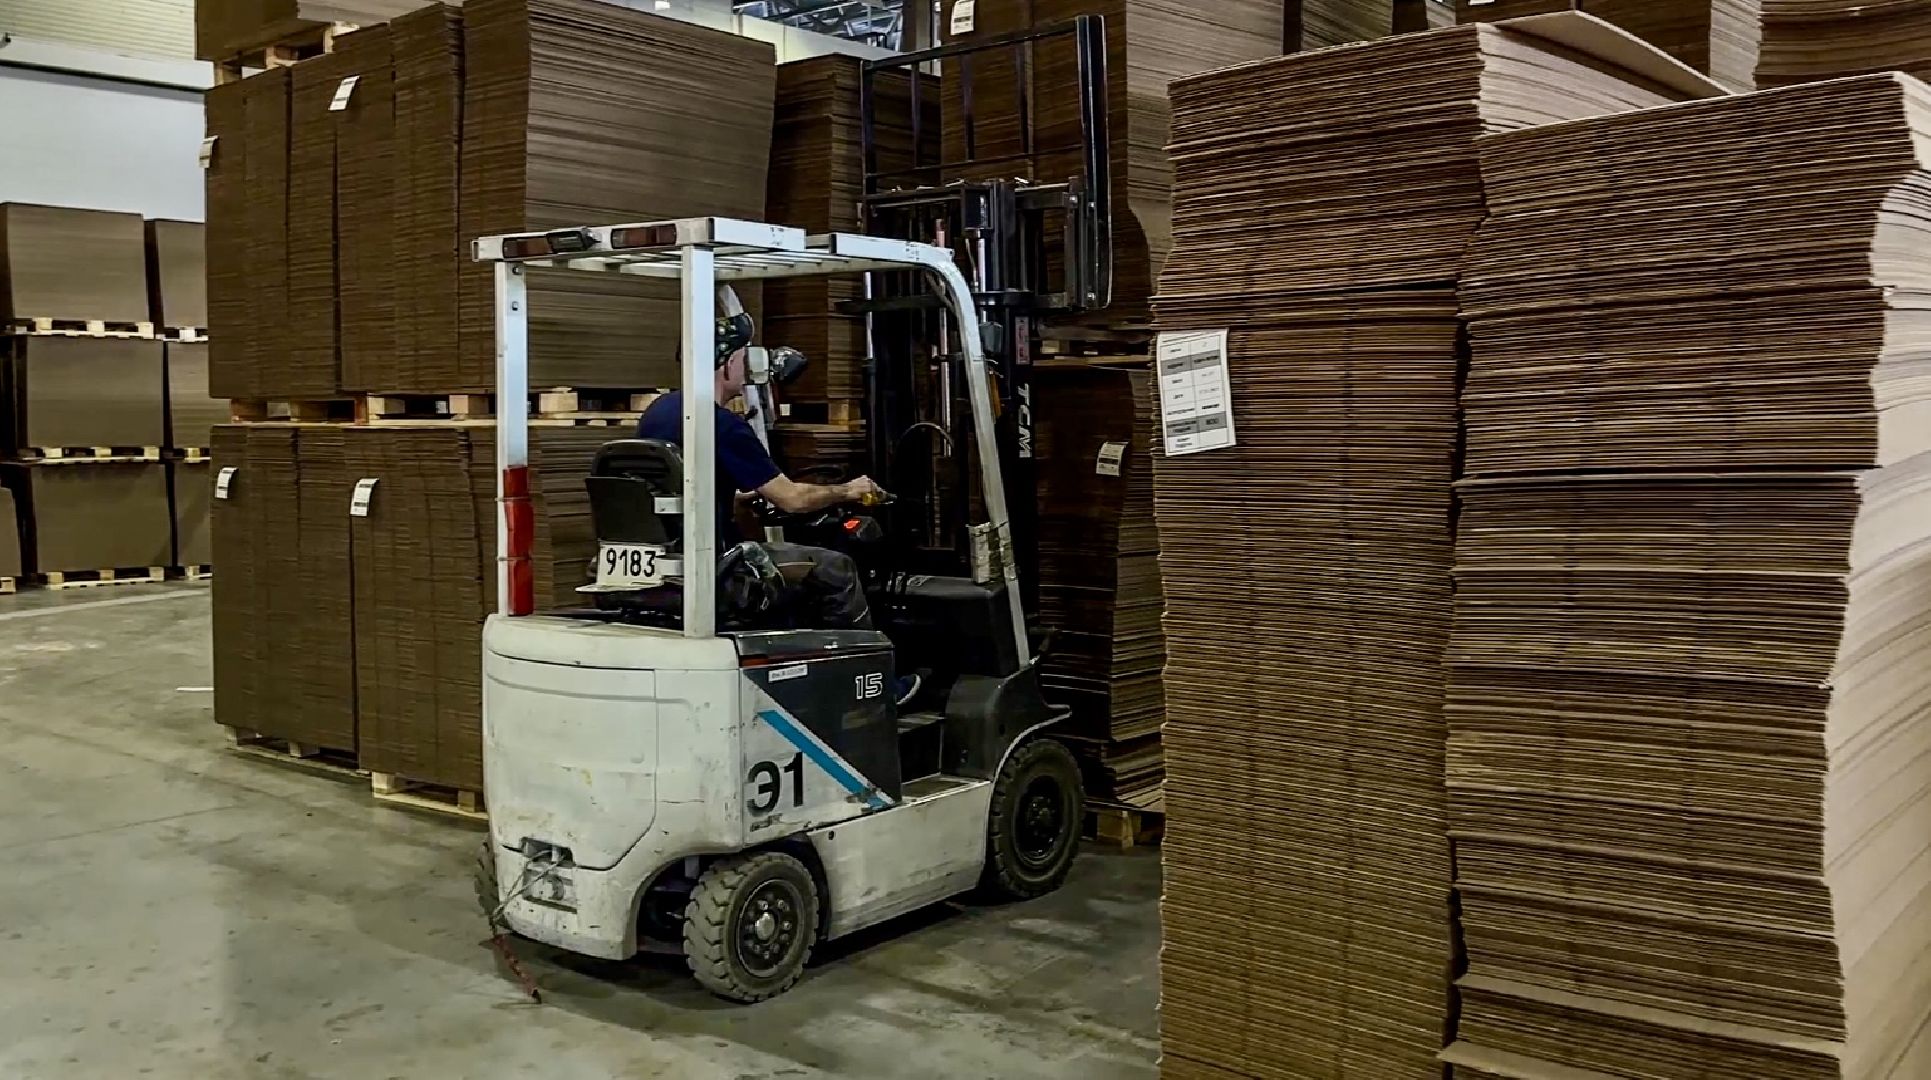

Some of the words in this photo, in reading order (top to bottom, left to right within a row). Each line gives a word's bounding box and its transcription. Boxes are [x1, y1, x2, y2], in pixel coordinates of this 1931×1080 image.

[1018, 383, 1031, 458] TCM
[606, 547, 656, 577] 9183
[855, 672, 882, 699] 15
